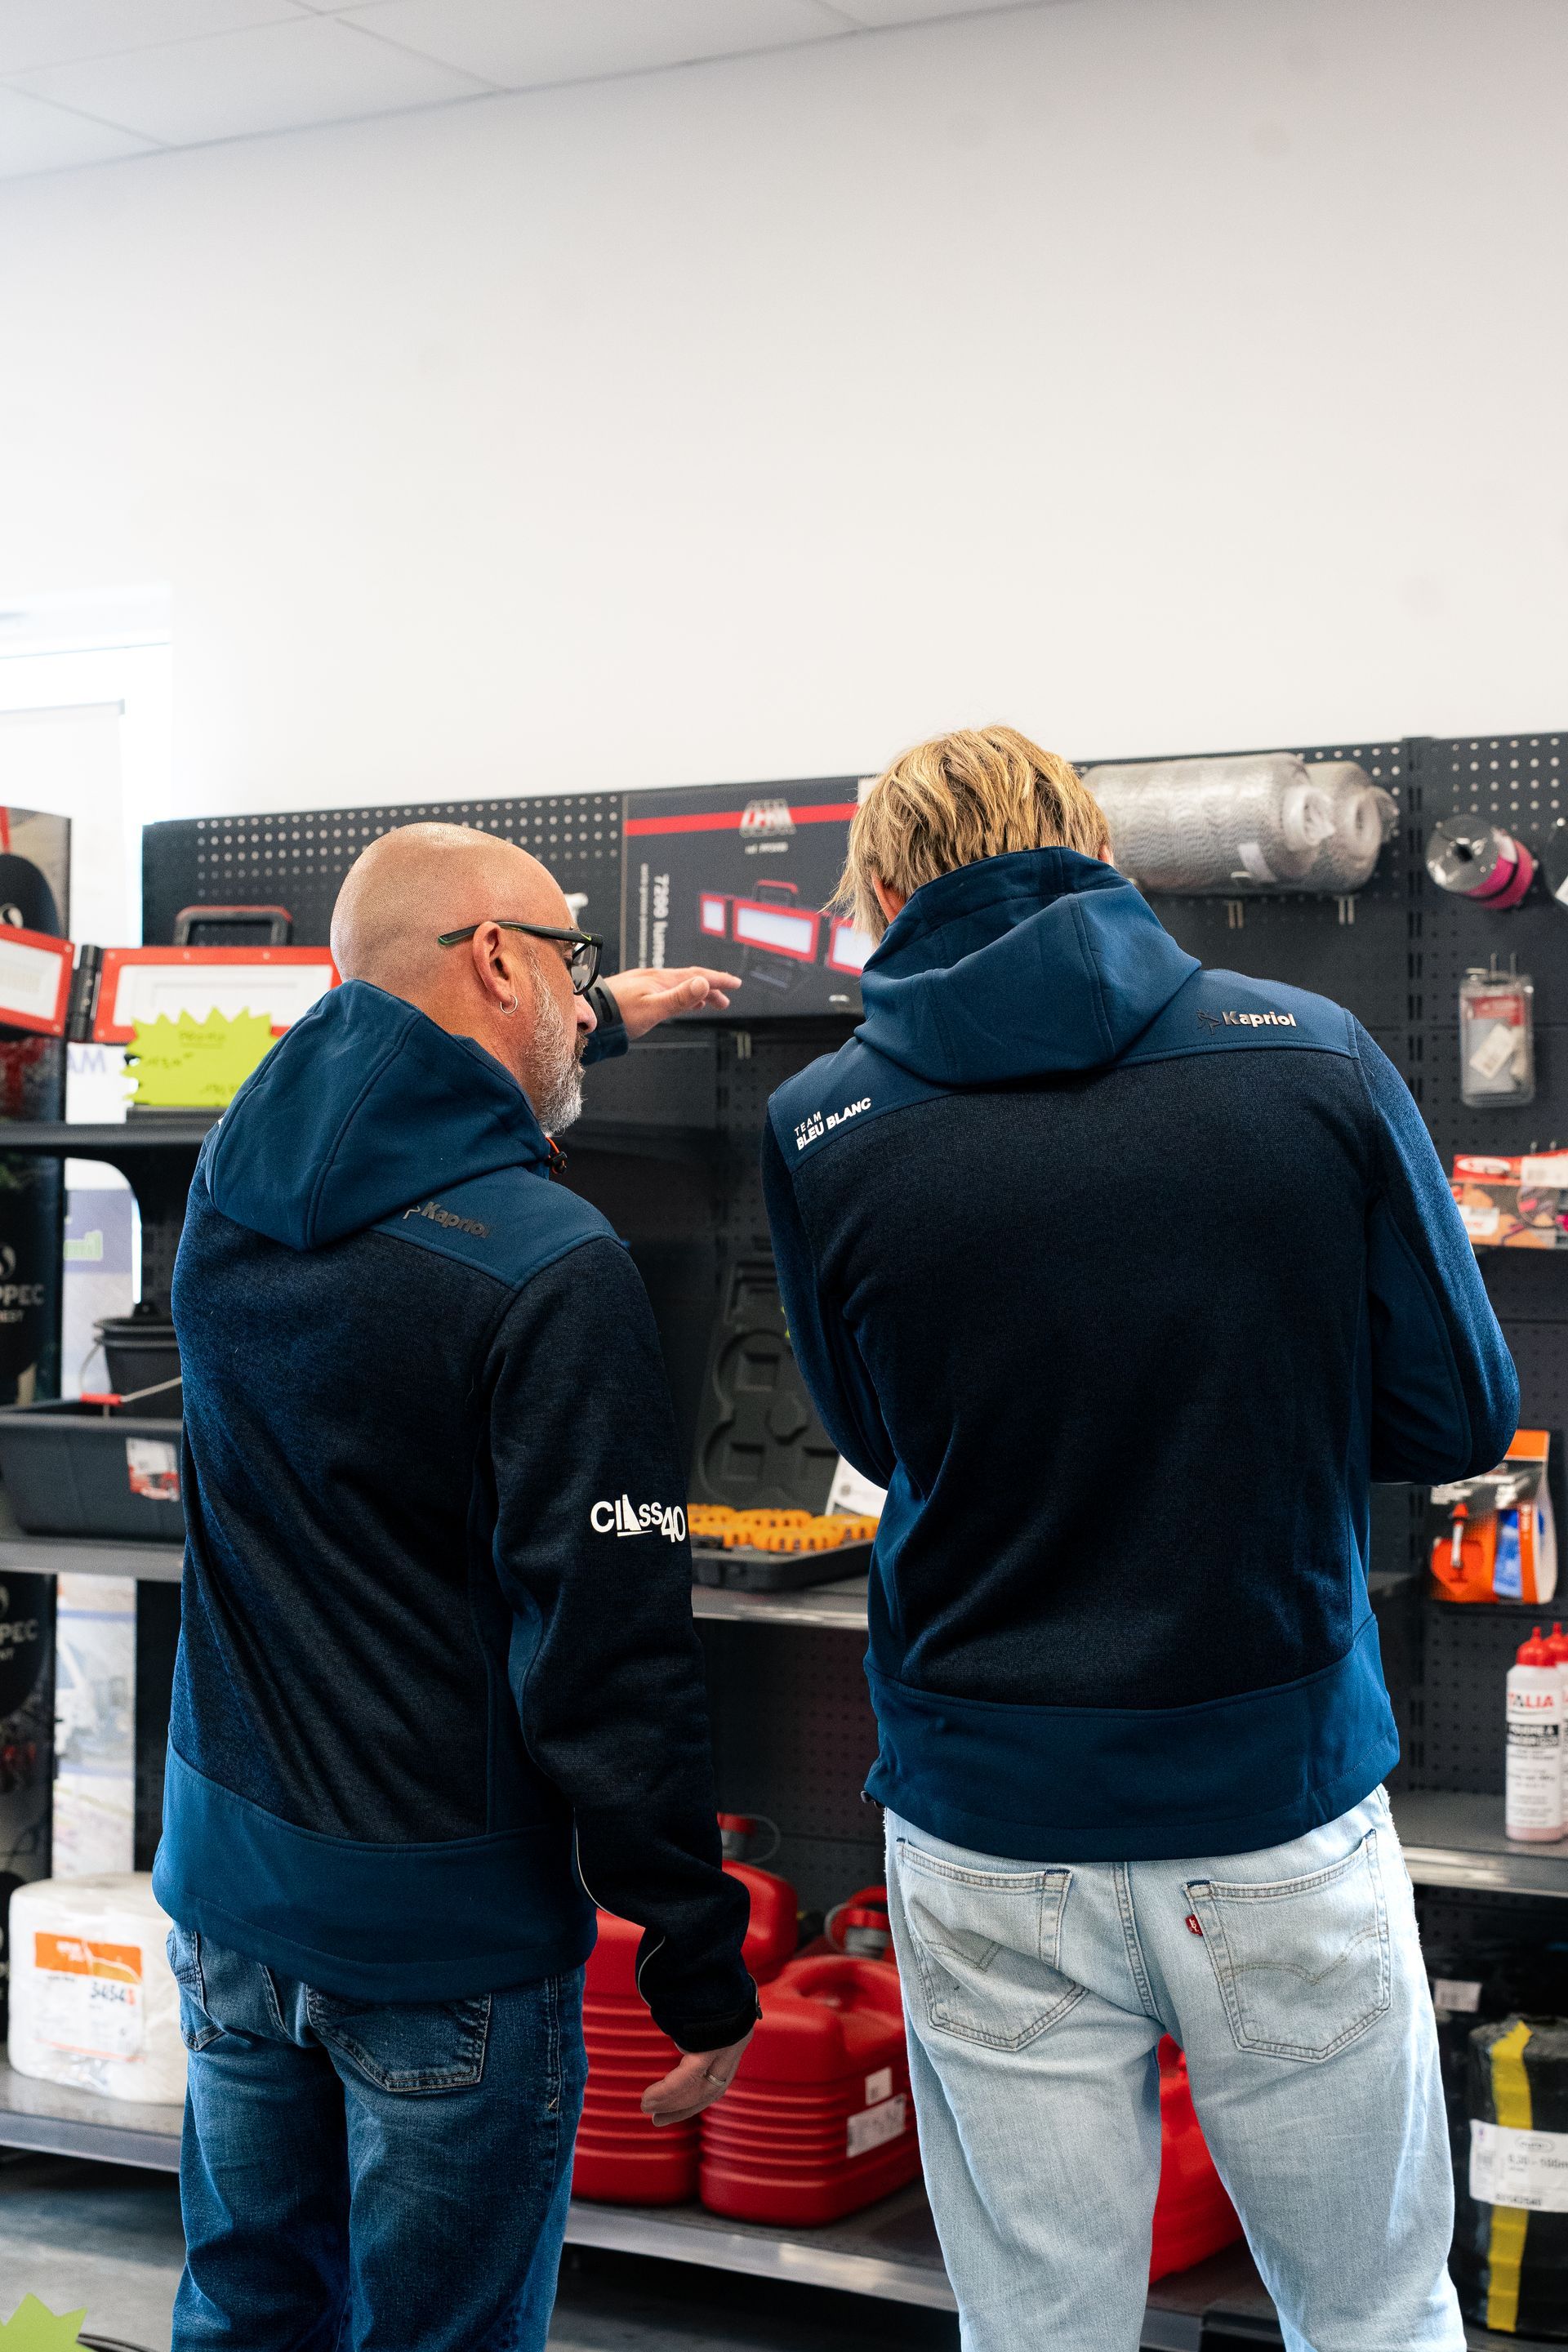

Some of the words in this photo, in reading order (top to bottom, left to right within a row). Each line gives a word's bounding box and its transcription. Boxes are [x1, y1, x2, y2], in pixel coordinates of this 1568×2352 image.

[1222, 1011, 1297, 1028] Kapriol
[794, 1111, 822, 1137] TEAM
[796, 1121, 825, 1151] BLEU
[826, 1097, 871, 1130] BLANC
